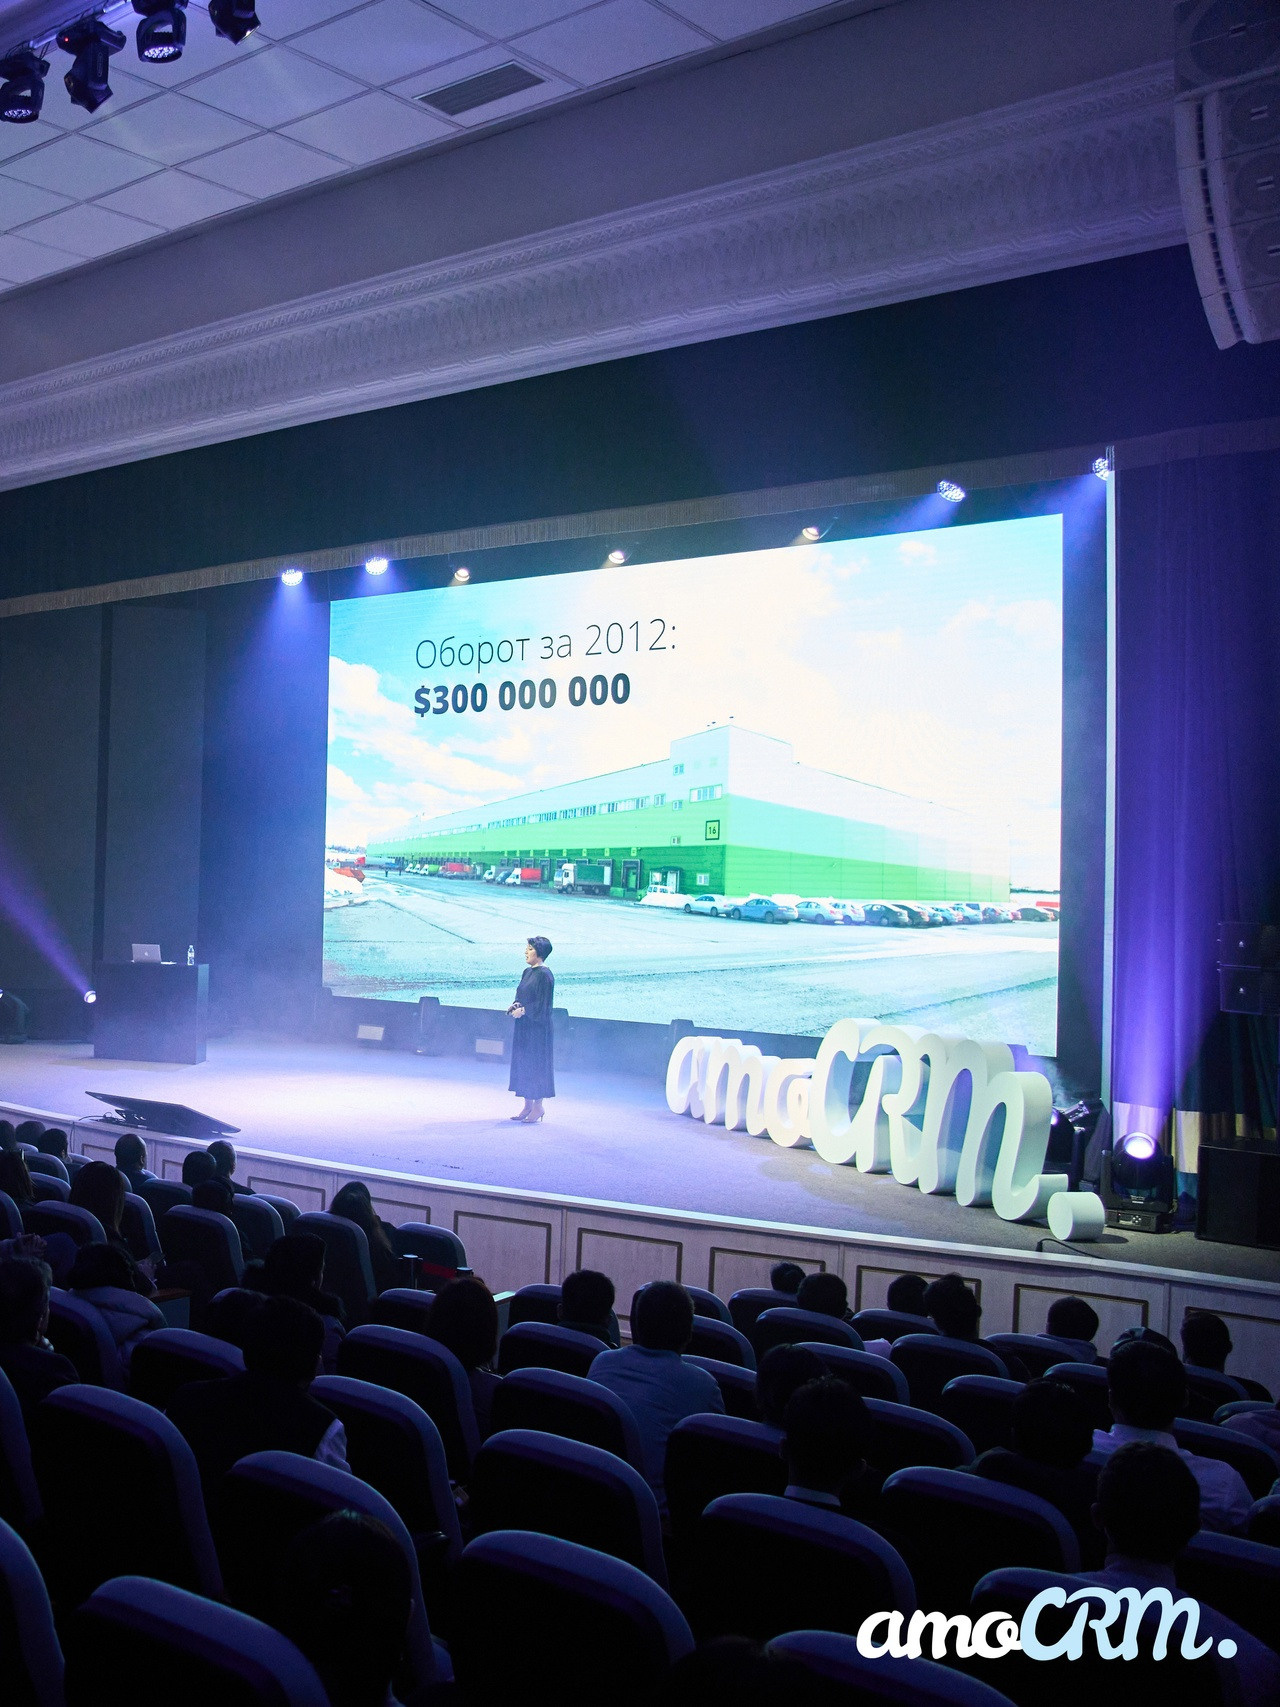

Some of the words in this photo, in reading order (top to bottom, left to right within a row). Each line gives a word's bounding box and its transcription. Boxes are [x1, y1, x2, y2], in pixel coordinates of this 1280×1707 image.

[416, 636, 531, 674] Оборот
[539, 634, 572, 660] за
[584, 618, 677, 656] 2012:
[414, 682, 488, 718] $300
[498, 678, 557, 711] 000
[568, 673, 631, 707] 000
